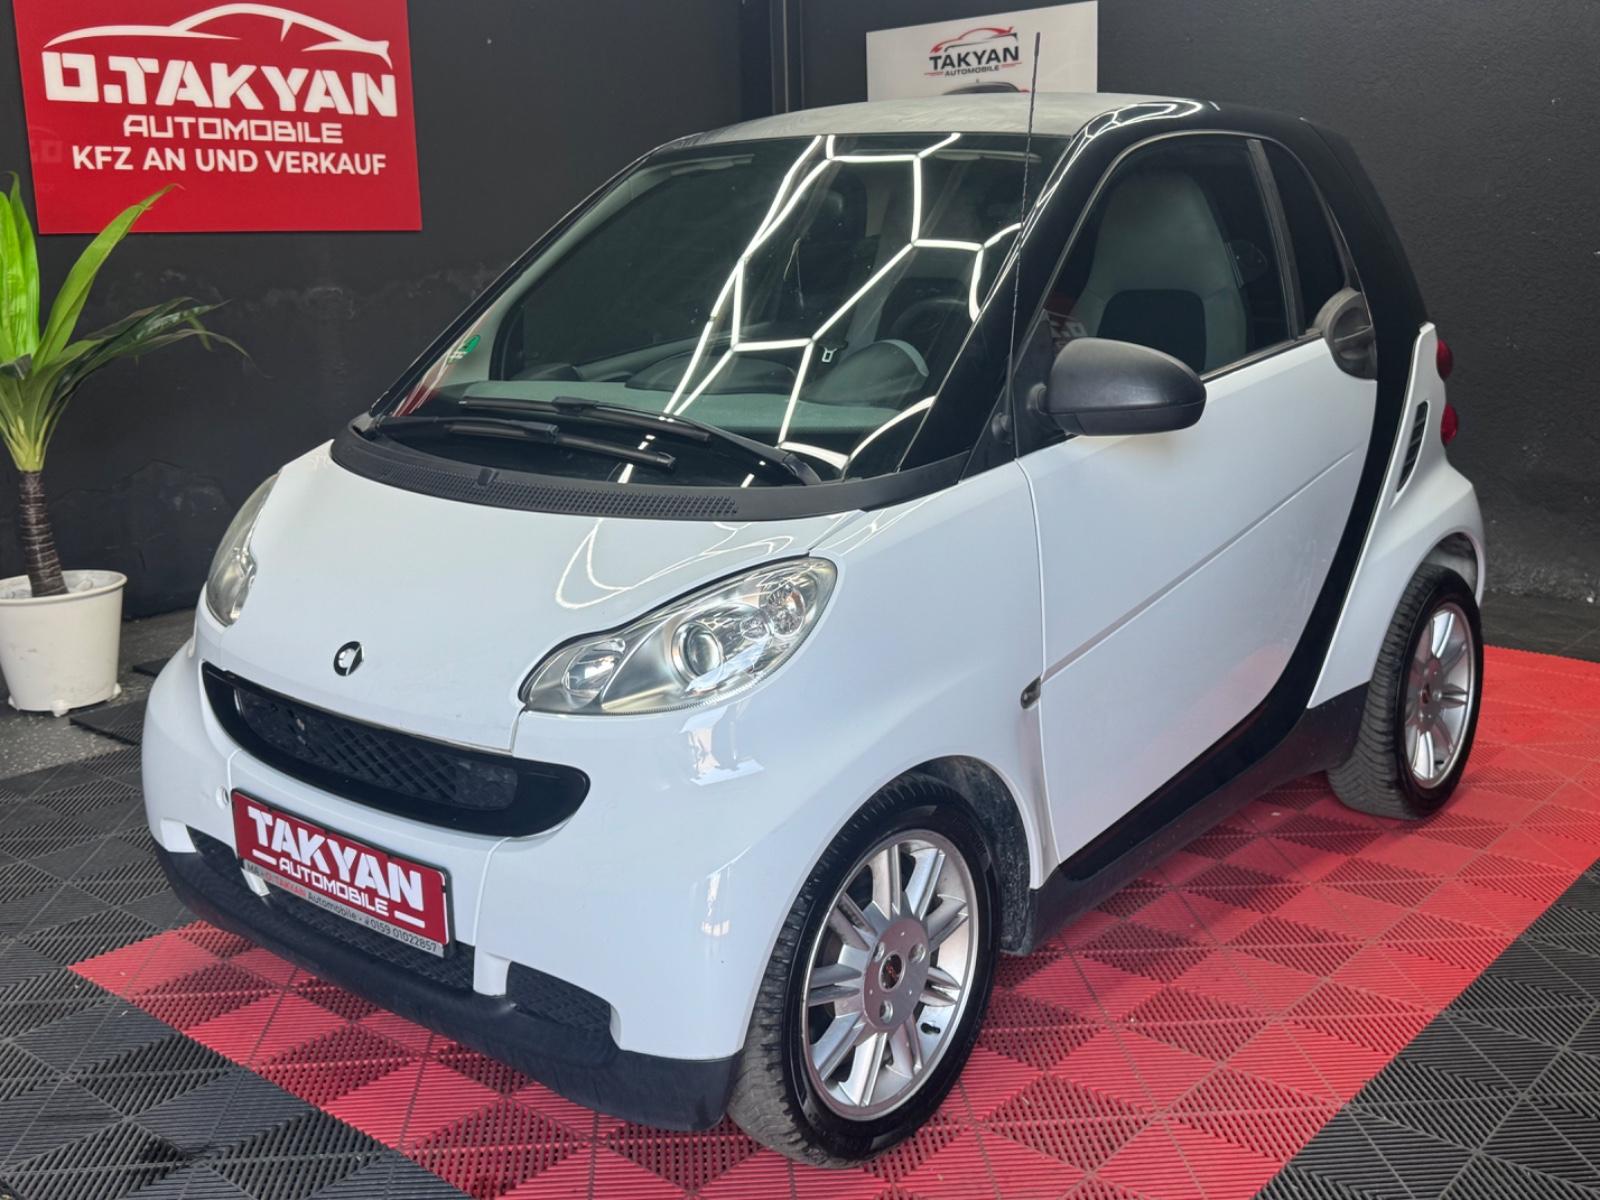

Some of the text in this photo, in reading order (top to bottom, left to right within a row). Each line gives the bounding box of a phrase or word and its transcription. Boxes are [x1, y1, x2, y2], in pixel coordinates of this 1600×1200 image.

[929, 46, 1020, 71] TAKYAN
[944, 65, 1000, 77] AUTOMOBILE
[123, 114, 344, 144] AUTOMOBILE
[71, 145, 387, 176] KFZ AN UND VERKAUF
[247, 805, 424, 912] TAKYAN
[278, 856, 390, 917] AUTOMOBILE
[370, 918, 391, 935] 0159
